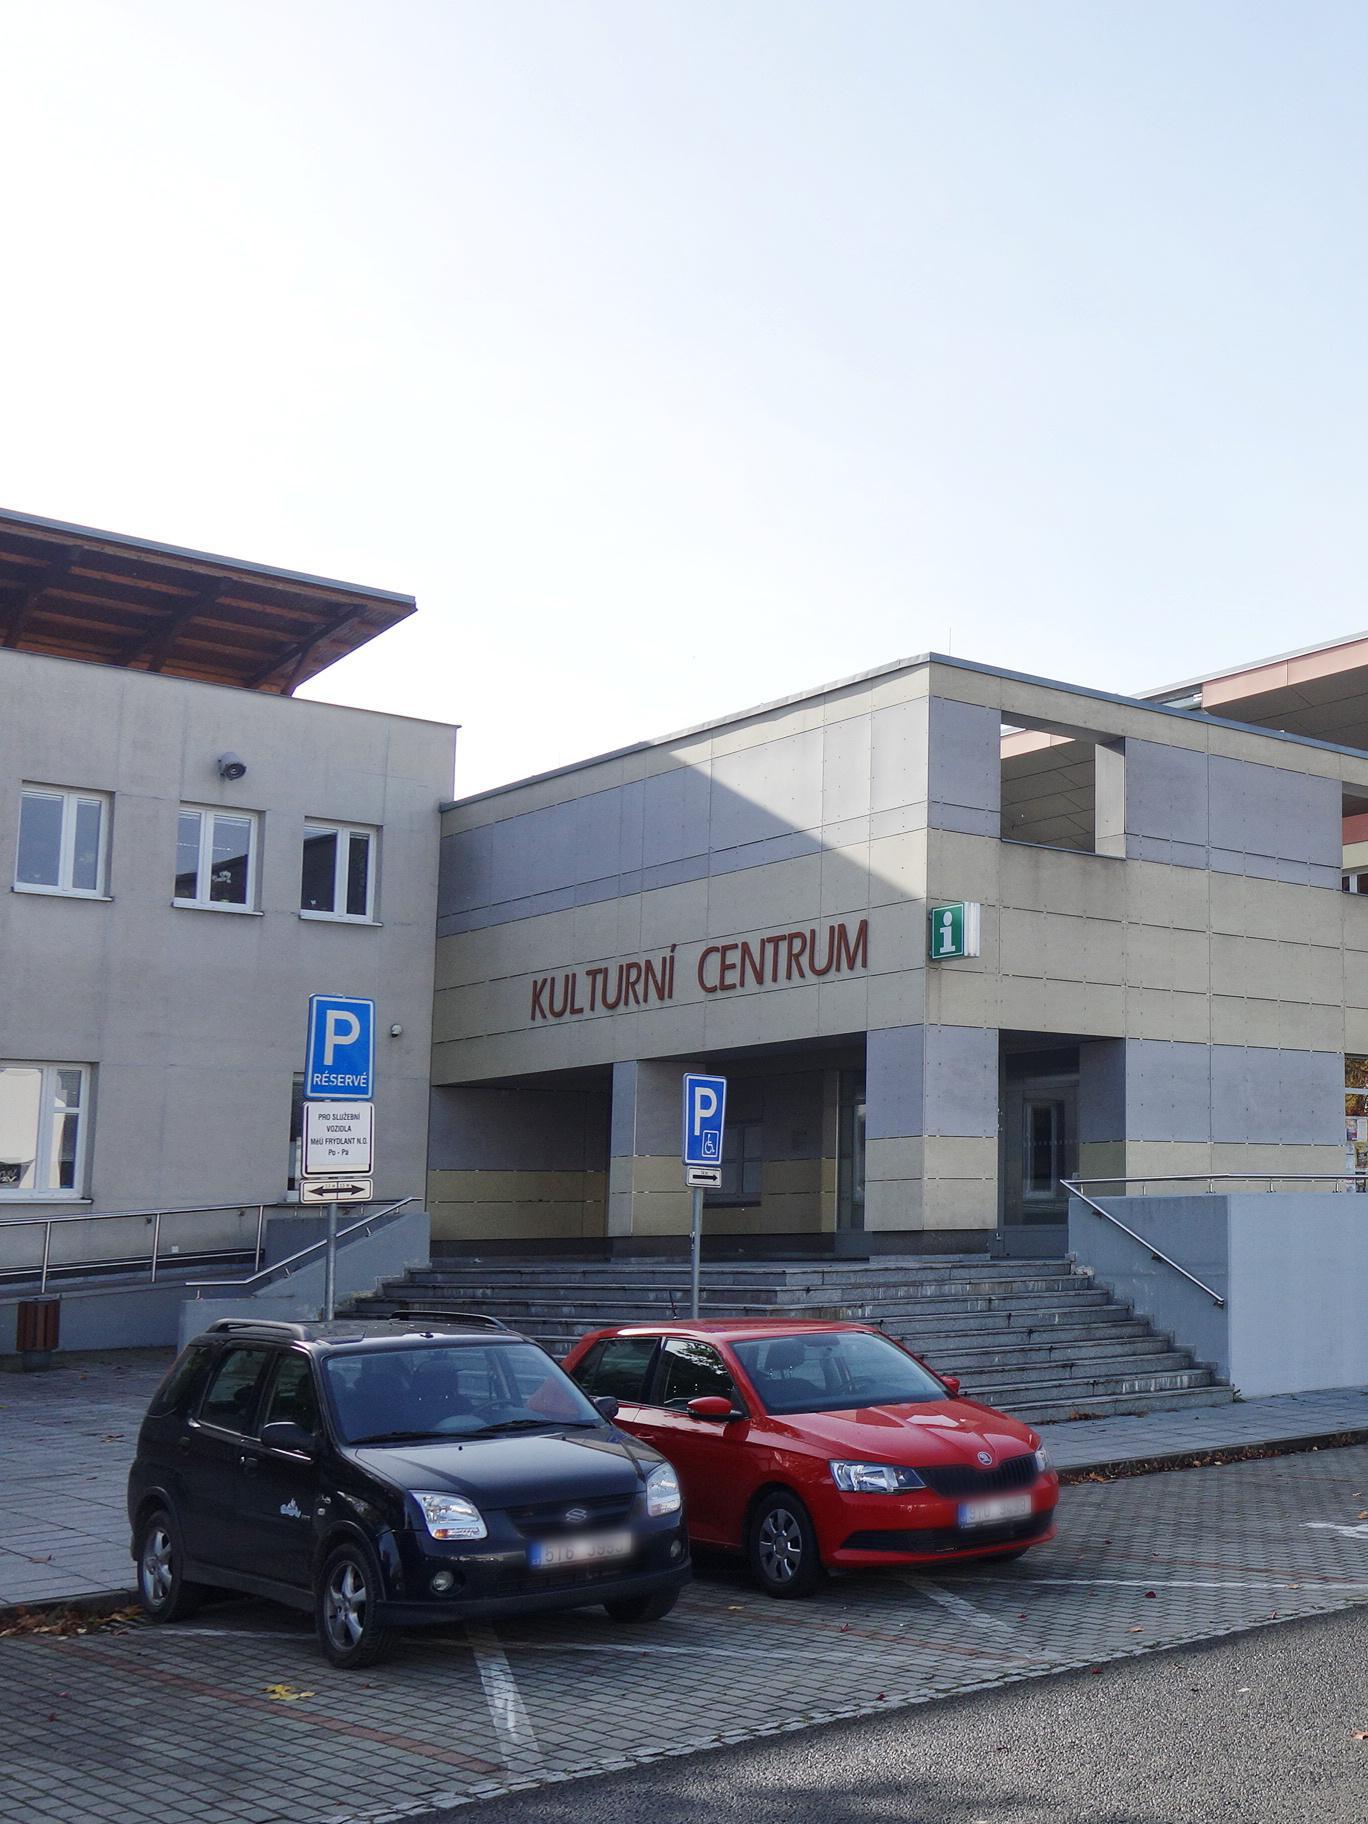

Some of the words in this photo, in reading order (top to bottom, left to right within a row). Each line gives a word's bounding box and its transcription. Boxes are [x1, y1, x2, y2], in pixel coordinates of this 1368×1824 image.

[530, 943, 676, 1021] KULTURNÍ
[697, 919, 868, 993] CENTRUM
[323, 1009, 361, 1066] P
[313, 1071, 368, 1087] RÉSERVÉ
[318, 1113, 331, 1121] PRO
[694, 1087, 717, 1136] P
[326, 1125, 352, 1133] VOZIDLA
